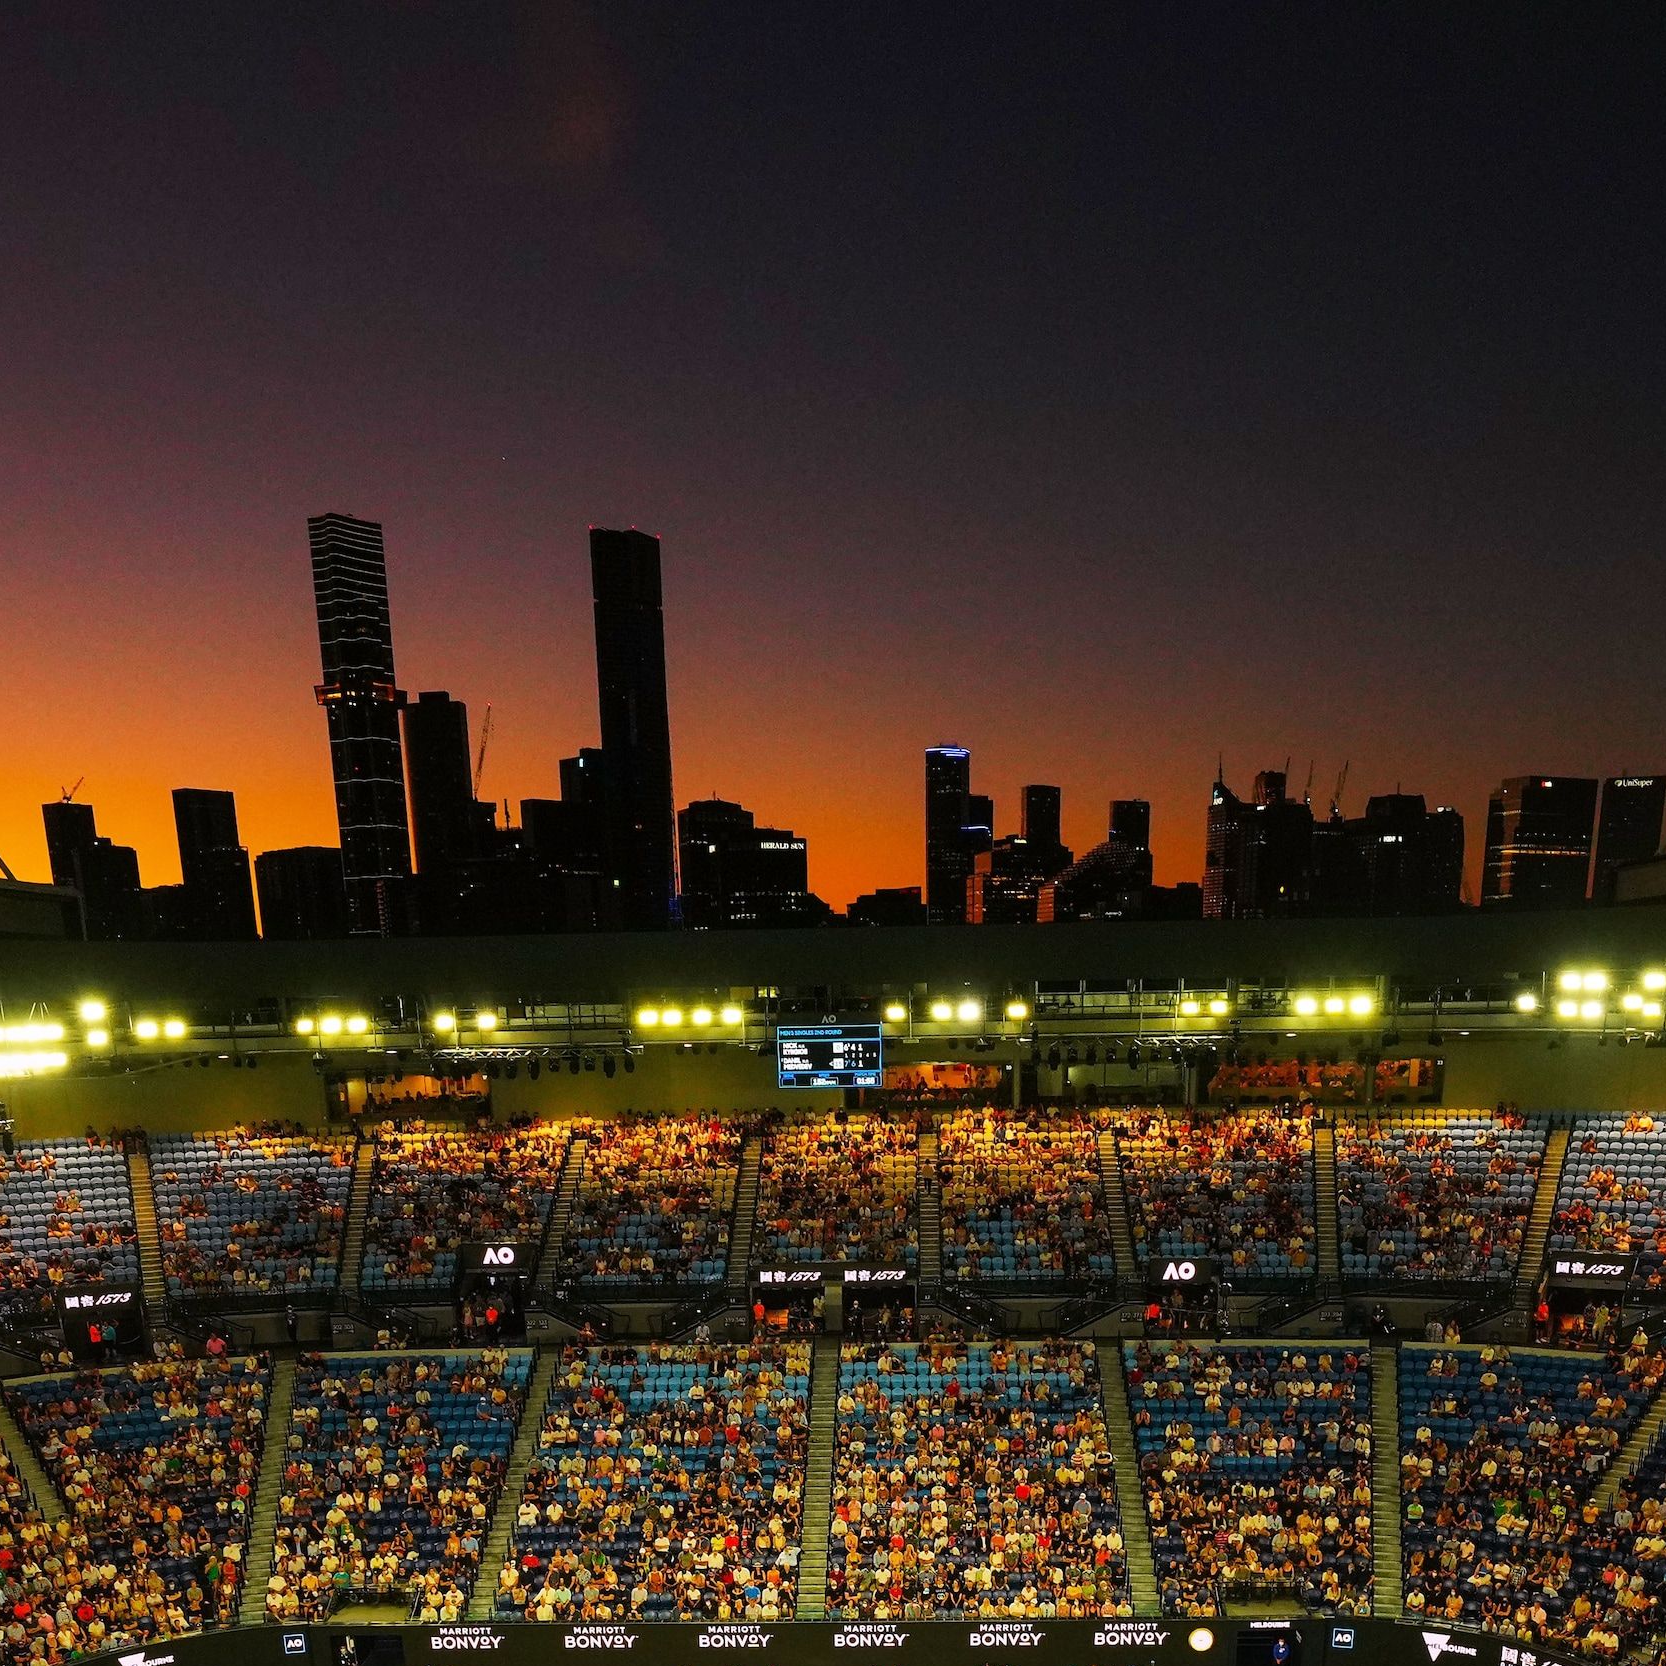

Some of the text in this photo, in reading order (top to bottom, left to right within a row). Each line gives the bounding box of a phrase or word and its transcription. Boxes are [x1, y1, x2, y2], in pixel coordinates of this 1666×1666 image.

[1622, 778, 1653, 788] UniSuper
[483, 1247, 514, 1265] AO
[1162, 1262, 1196, 1280] AO
[439, 1626, 492, 1635] MARRIOTT
[573, 1625, 626, 1635] MARRIOTT
[707, 1625, 760, 1634] MARRIOTT
[843, 1624, 896, 1633] MARRIOTT
[979, 1623, 1032, 1632] MARRIOTT
[1104, 1622, 1157, 1631] MARRIOTT
[431, 1635, 502, 1649] BONVOY
[565, 1635, 636, 1649] BONVOY
[699, 1634, 770, 1648] BONVOY
[835, 1633, 906, 1647] BONVOY
[970, 1632, 1041, 1646] BONVOY
[1095, 1631, 1166, 1645] BONVOY
[1335, 1632, 1352, 1643] AO
[287, 1639, 302, 1648] AO
